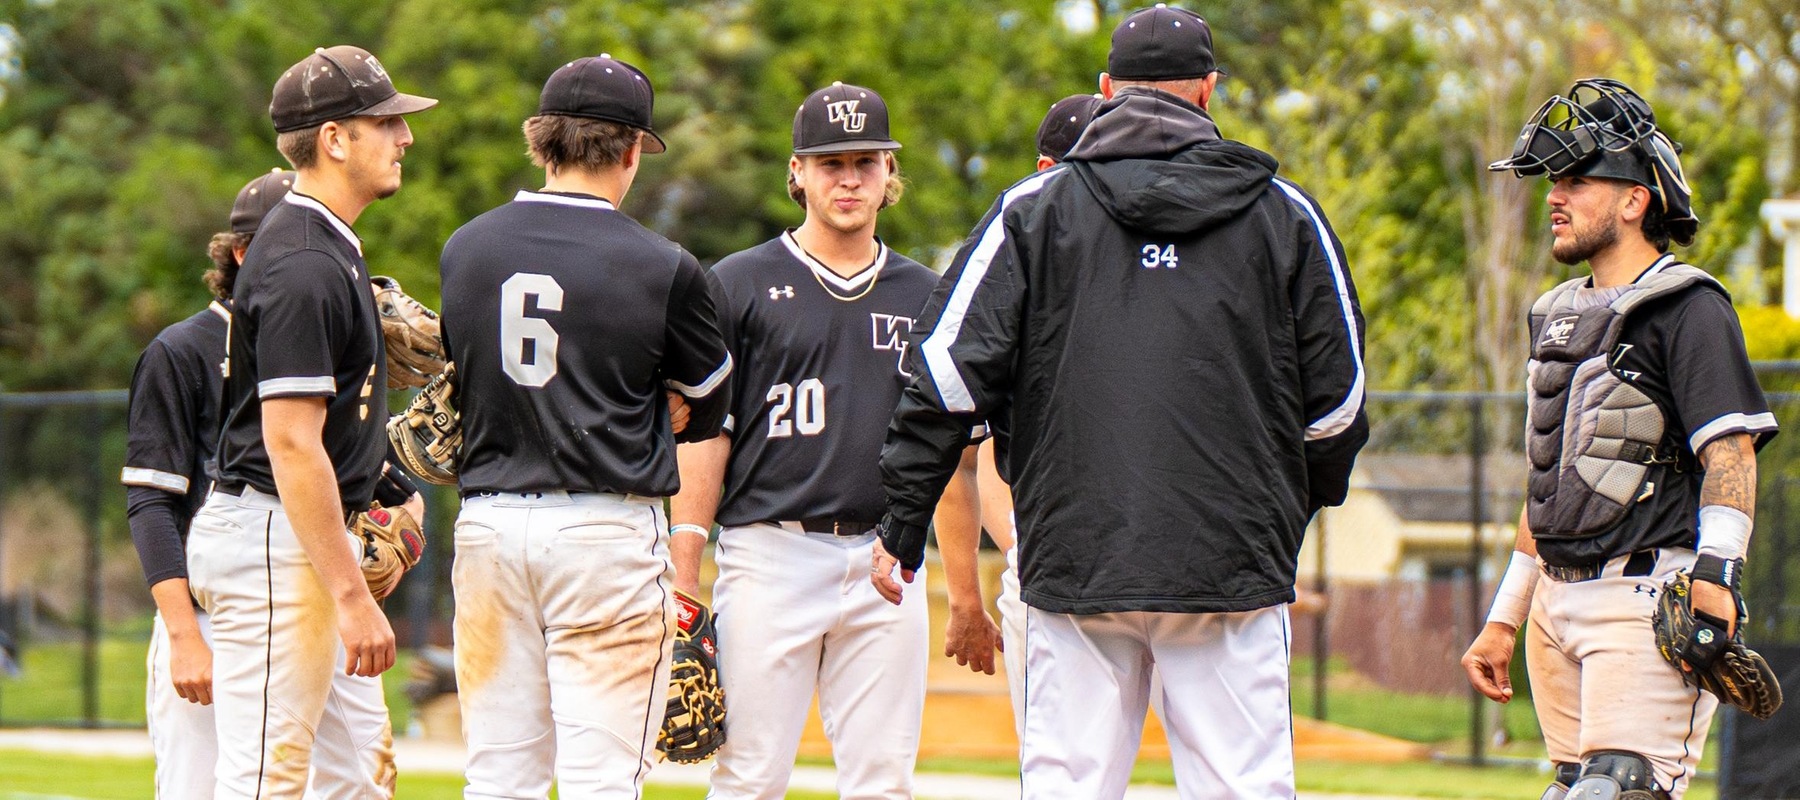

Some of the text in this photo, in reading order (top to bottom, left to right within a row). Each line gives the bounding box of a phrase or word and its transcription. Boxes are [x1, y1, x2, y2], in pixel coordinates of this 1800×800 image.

[826, 99, 867, 132] WU
[1141, 244, 1179, 268] 34
[501, 272, 564, 388] 6
[766, 377, 826, 438] 20
